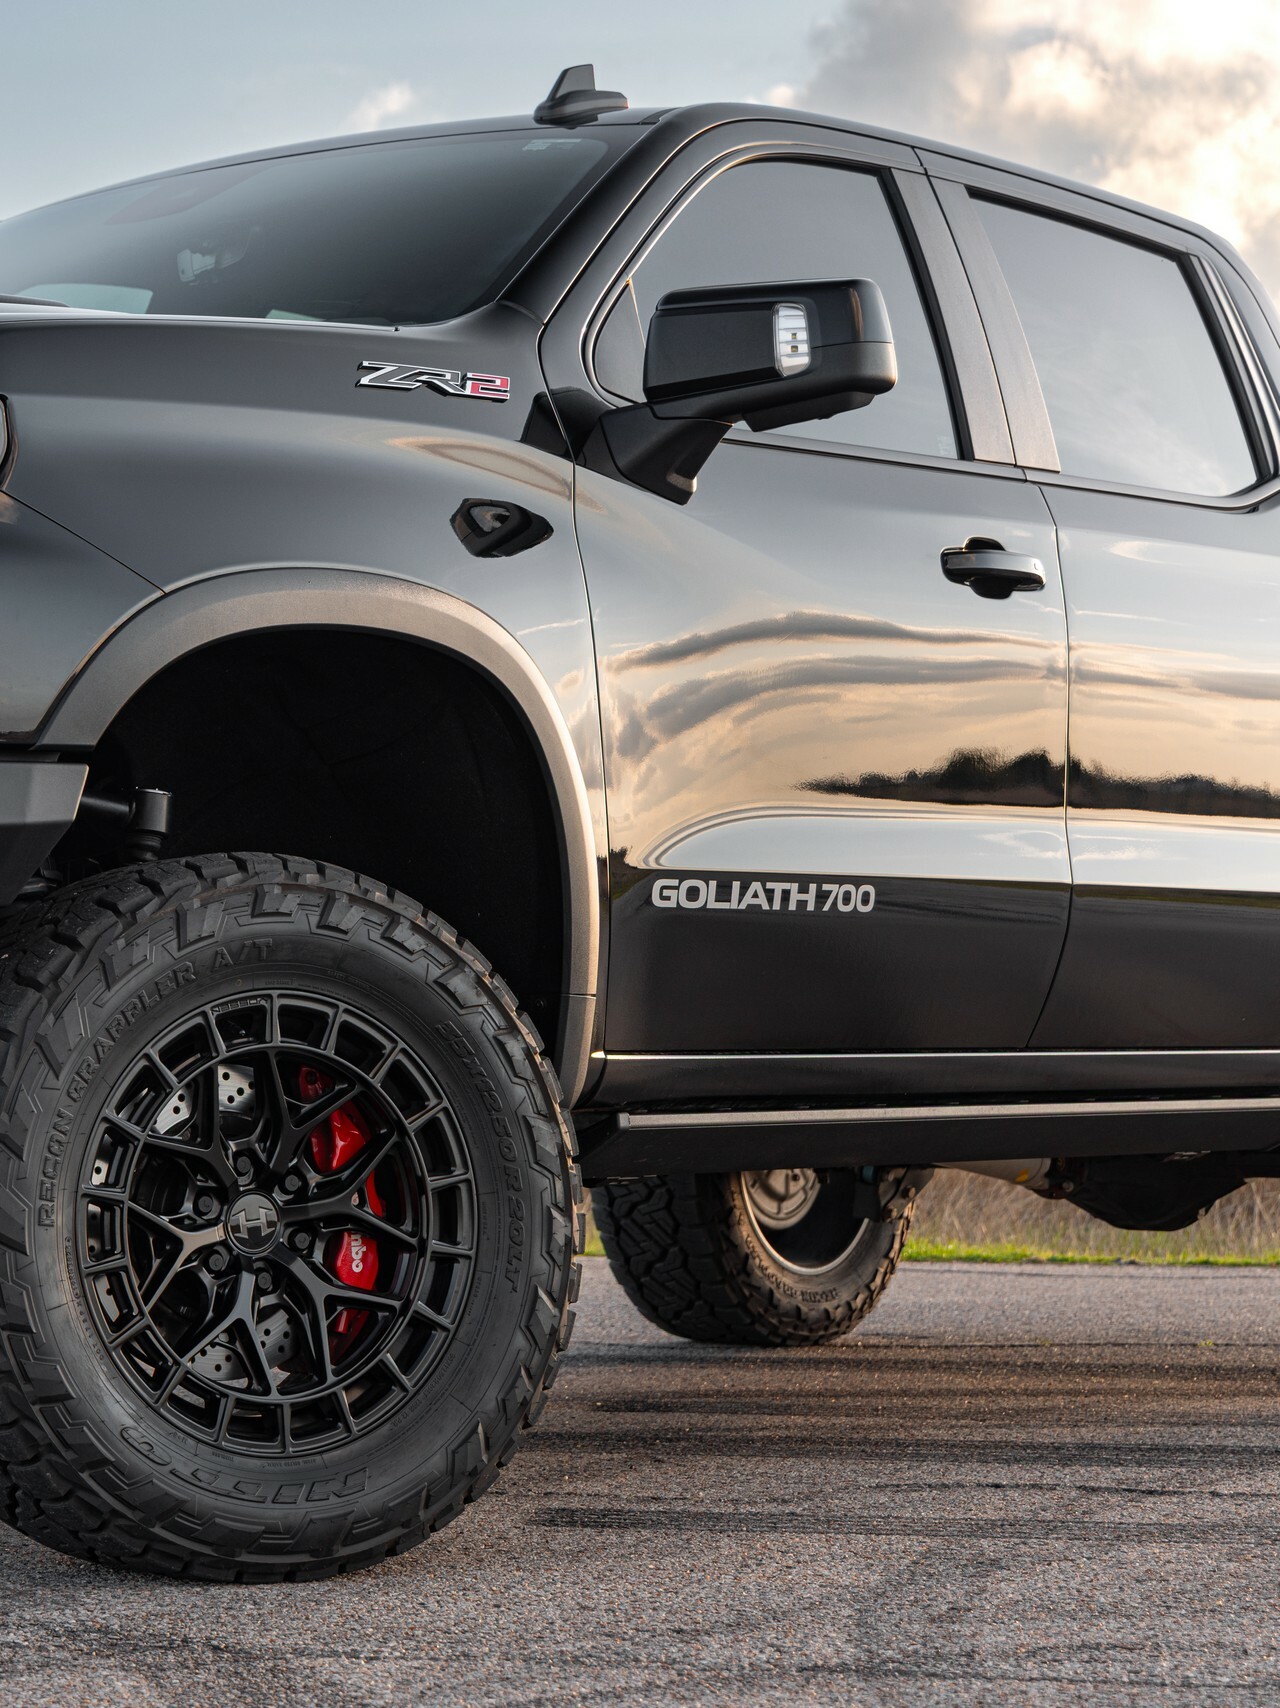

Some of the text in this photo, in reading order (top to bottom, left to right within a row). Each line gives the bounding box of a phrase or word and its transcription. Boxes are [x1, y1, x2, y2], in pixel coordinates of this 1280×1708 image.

[355, 360, 510, 403] ZR2
[651, 878, 876, 913] GOLIATH 700
[37, 1107, 75, 1227] RECON
[66, 960, 197, 1104] GRAPPLER
[119, 1426, 369, 1504] NITTO
